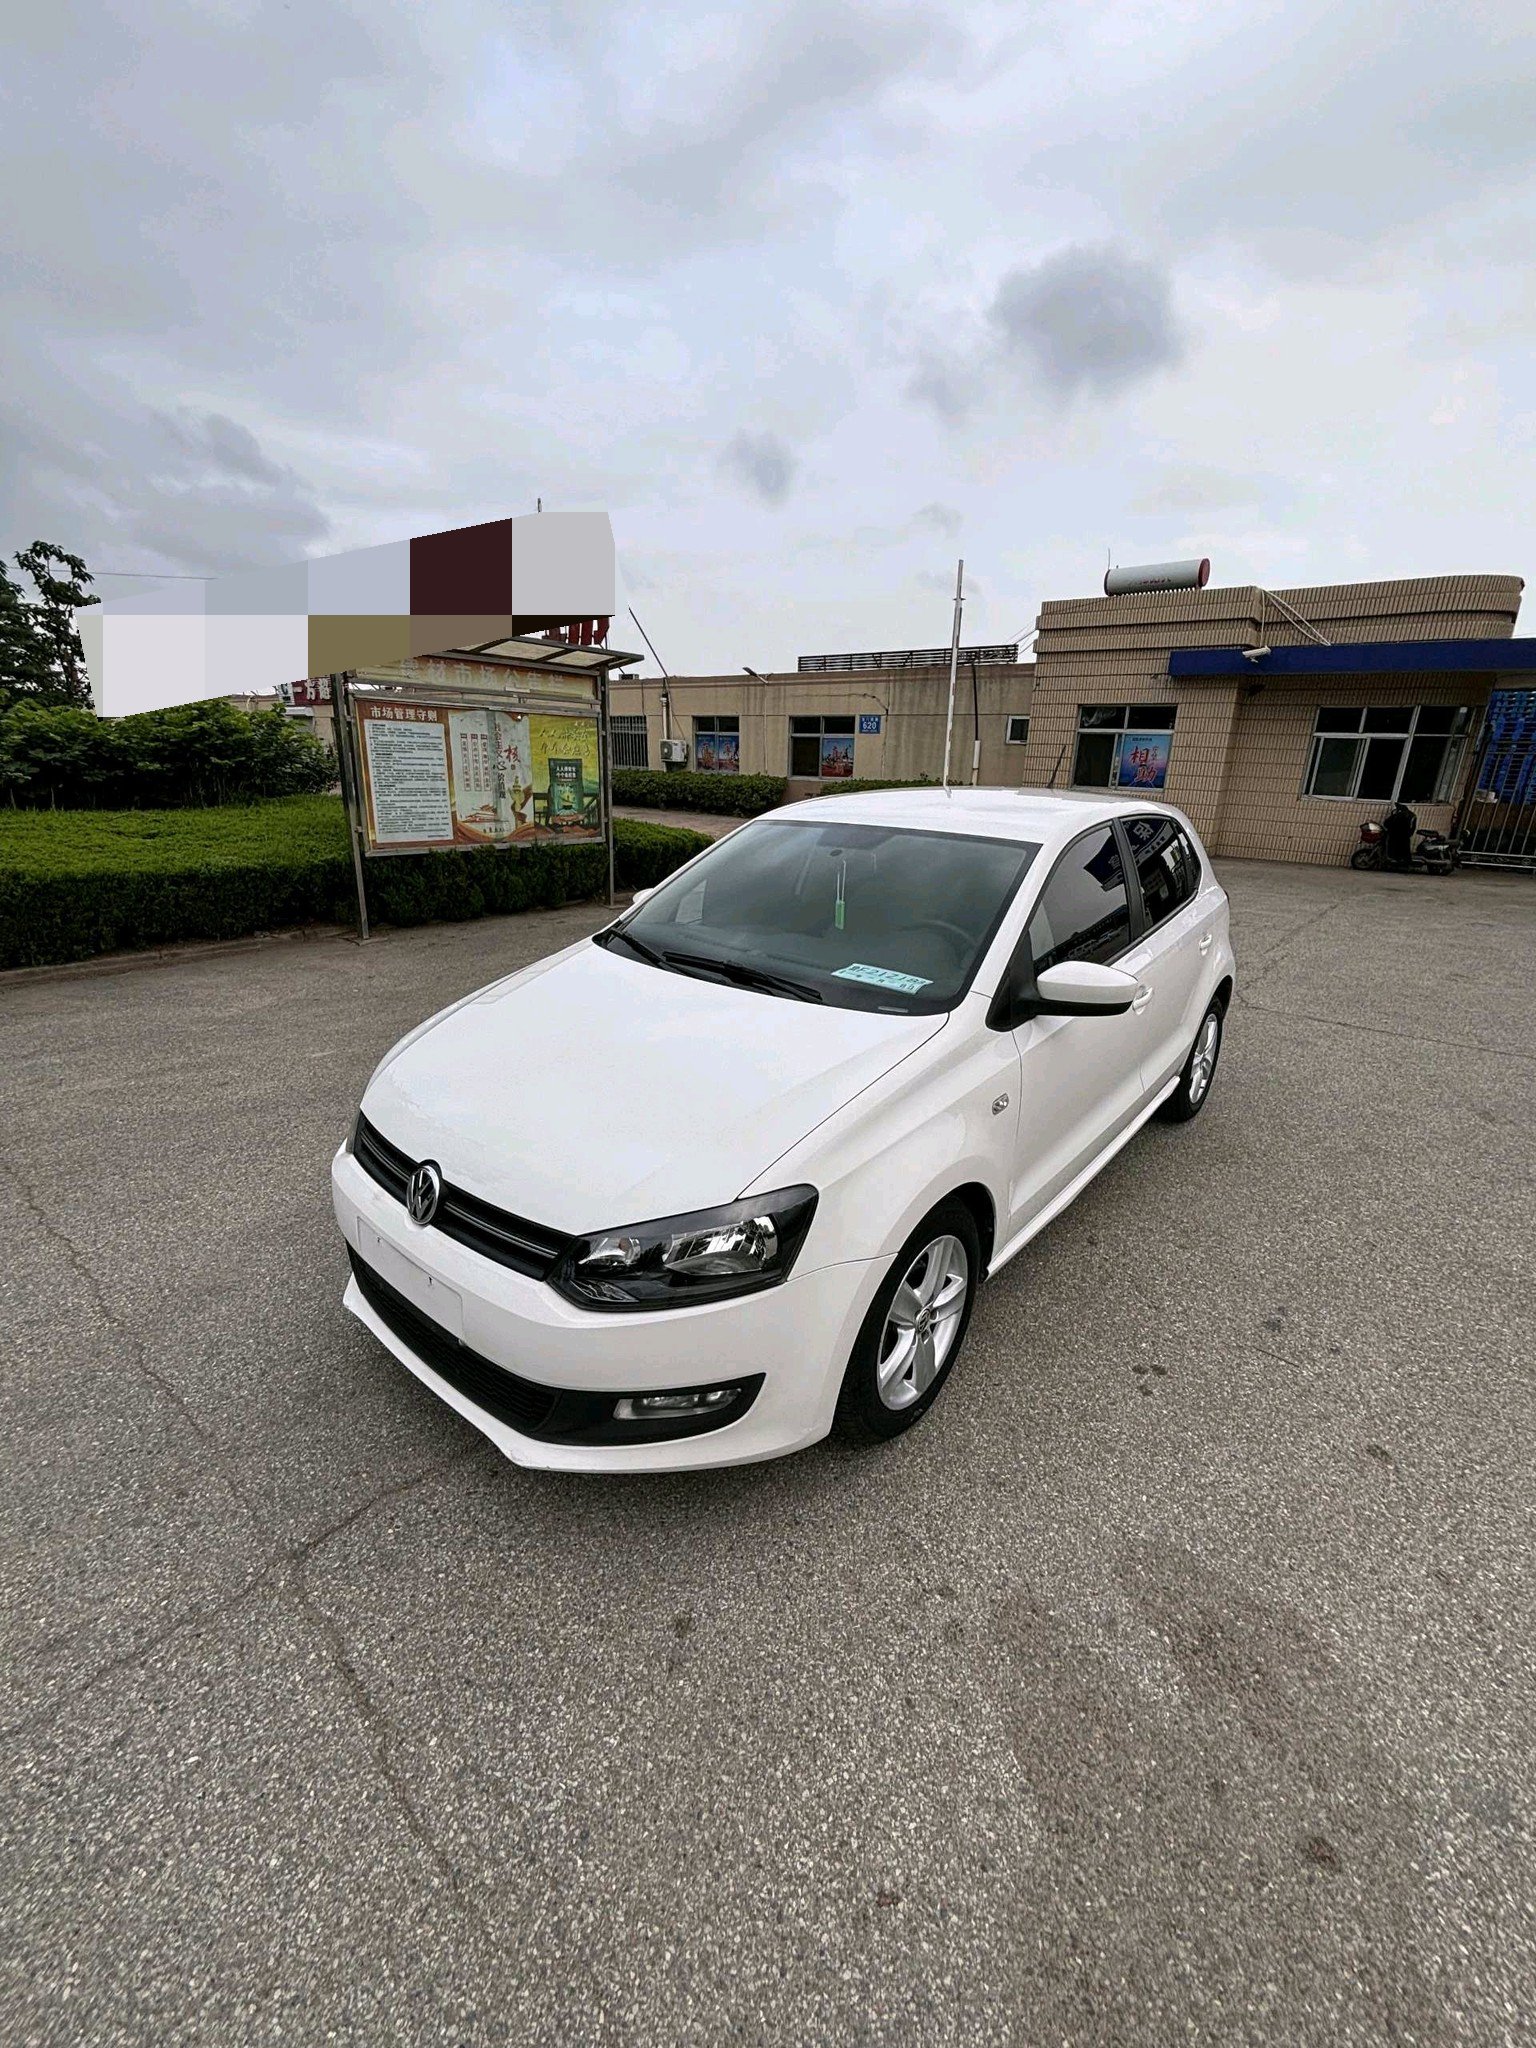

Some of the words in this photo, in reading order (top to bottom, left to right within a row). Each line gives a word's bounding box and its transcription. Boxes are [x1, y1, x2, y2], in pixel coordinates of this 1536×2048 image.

[370, 706, 438, 721] 市场管理守则
[862, 721, 877, 730] 620
[503, 744, 521, 763] 核
